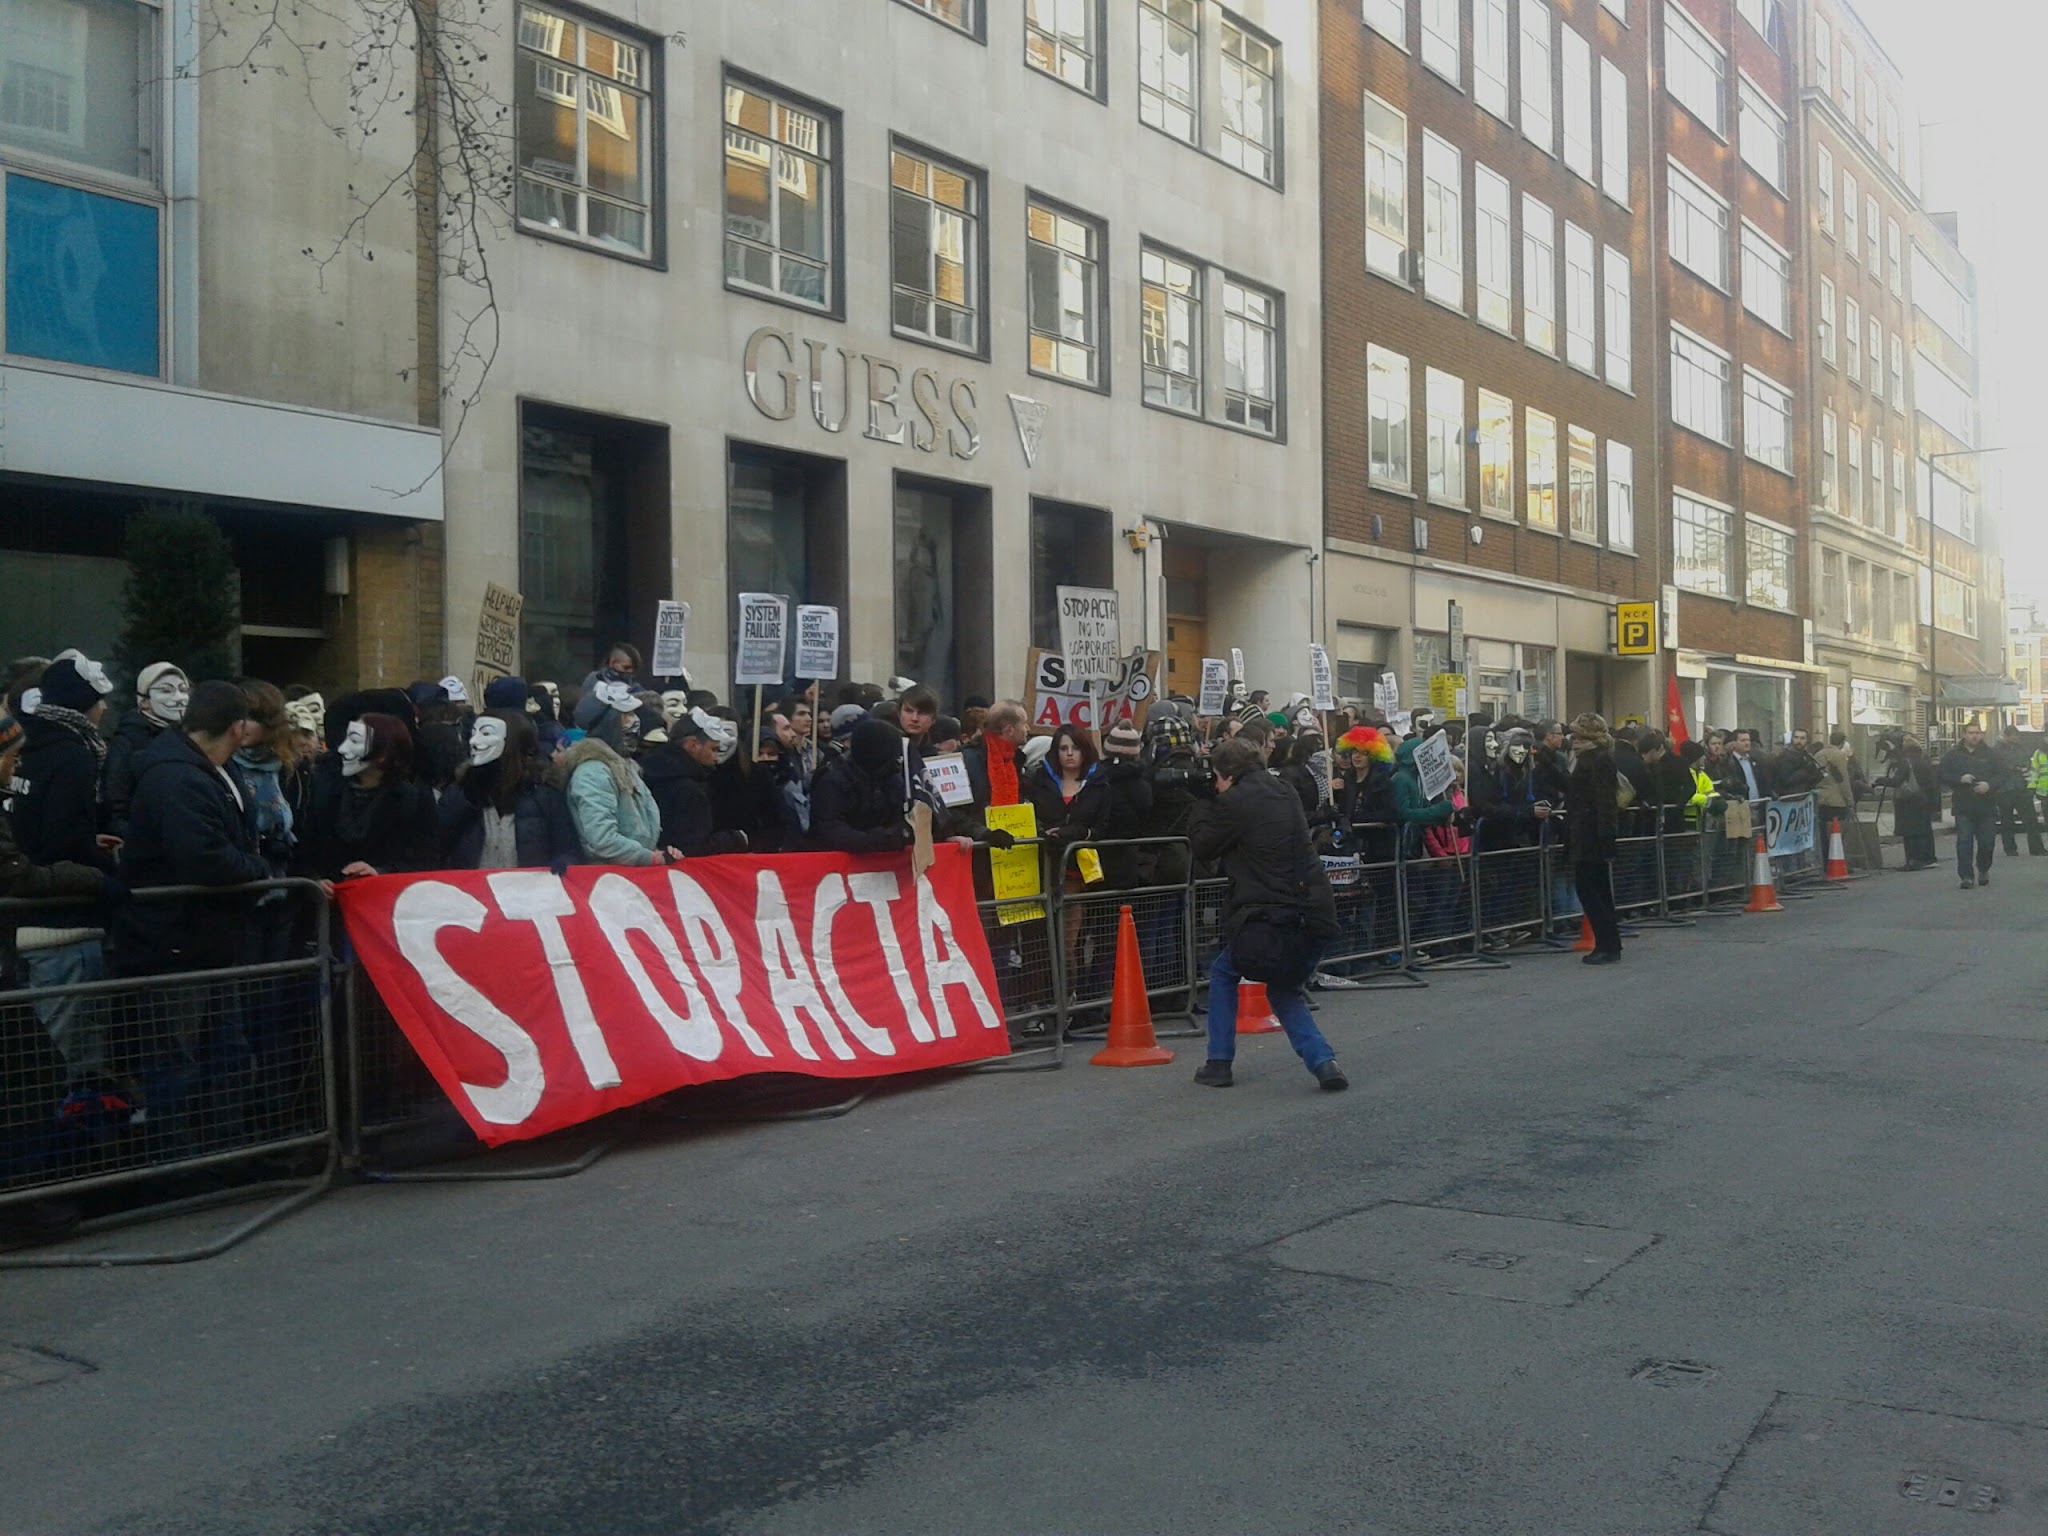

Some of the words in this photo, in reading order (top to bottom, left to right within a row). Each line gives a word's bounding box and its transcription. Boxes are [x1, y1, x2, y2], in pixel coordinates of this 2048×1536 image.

[744, 326, 981, 460] GUESS
[745, 605, 781, 622] SYSTEM
[1063, 597, 1090, 618] STOP
[1091, 598, 1117, 621] ACTA
[660, 611, 684, 625] SYSTEM
[802, 614, 823, 623] DON'T
[745, 622, 782, 639] FAILURE
[802, 623, 820, 631] SHUT
[1079, 620, 1092, 637] NO
[1095, 621, 1106, 637] TO
[802, 640, 833, 649] INTERNET
[1071, 657, 1119, 677] MENTALITY
[930, 768, 941, 778] SAY
[941, 767, 951, 776] NO
[950, 764, 959, 774] TO
[940, 781, 957, 792] ACTA
[394, 870, 773, 1125] STOP
[755, 868, 1000, 1061] ACTA
